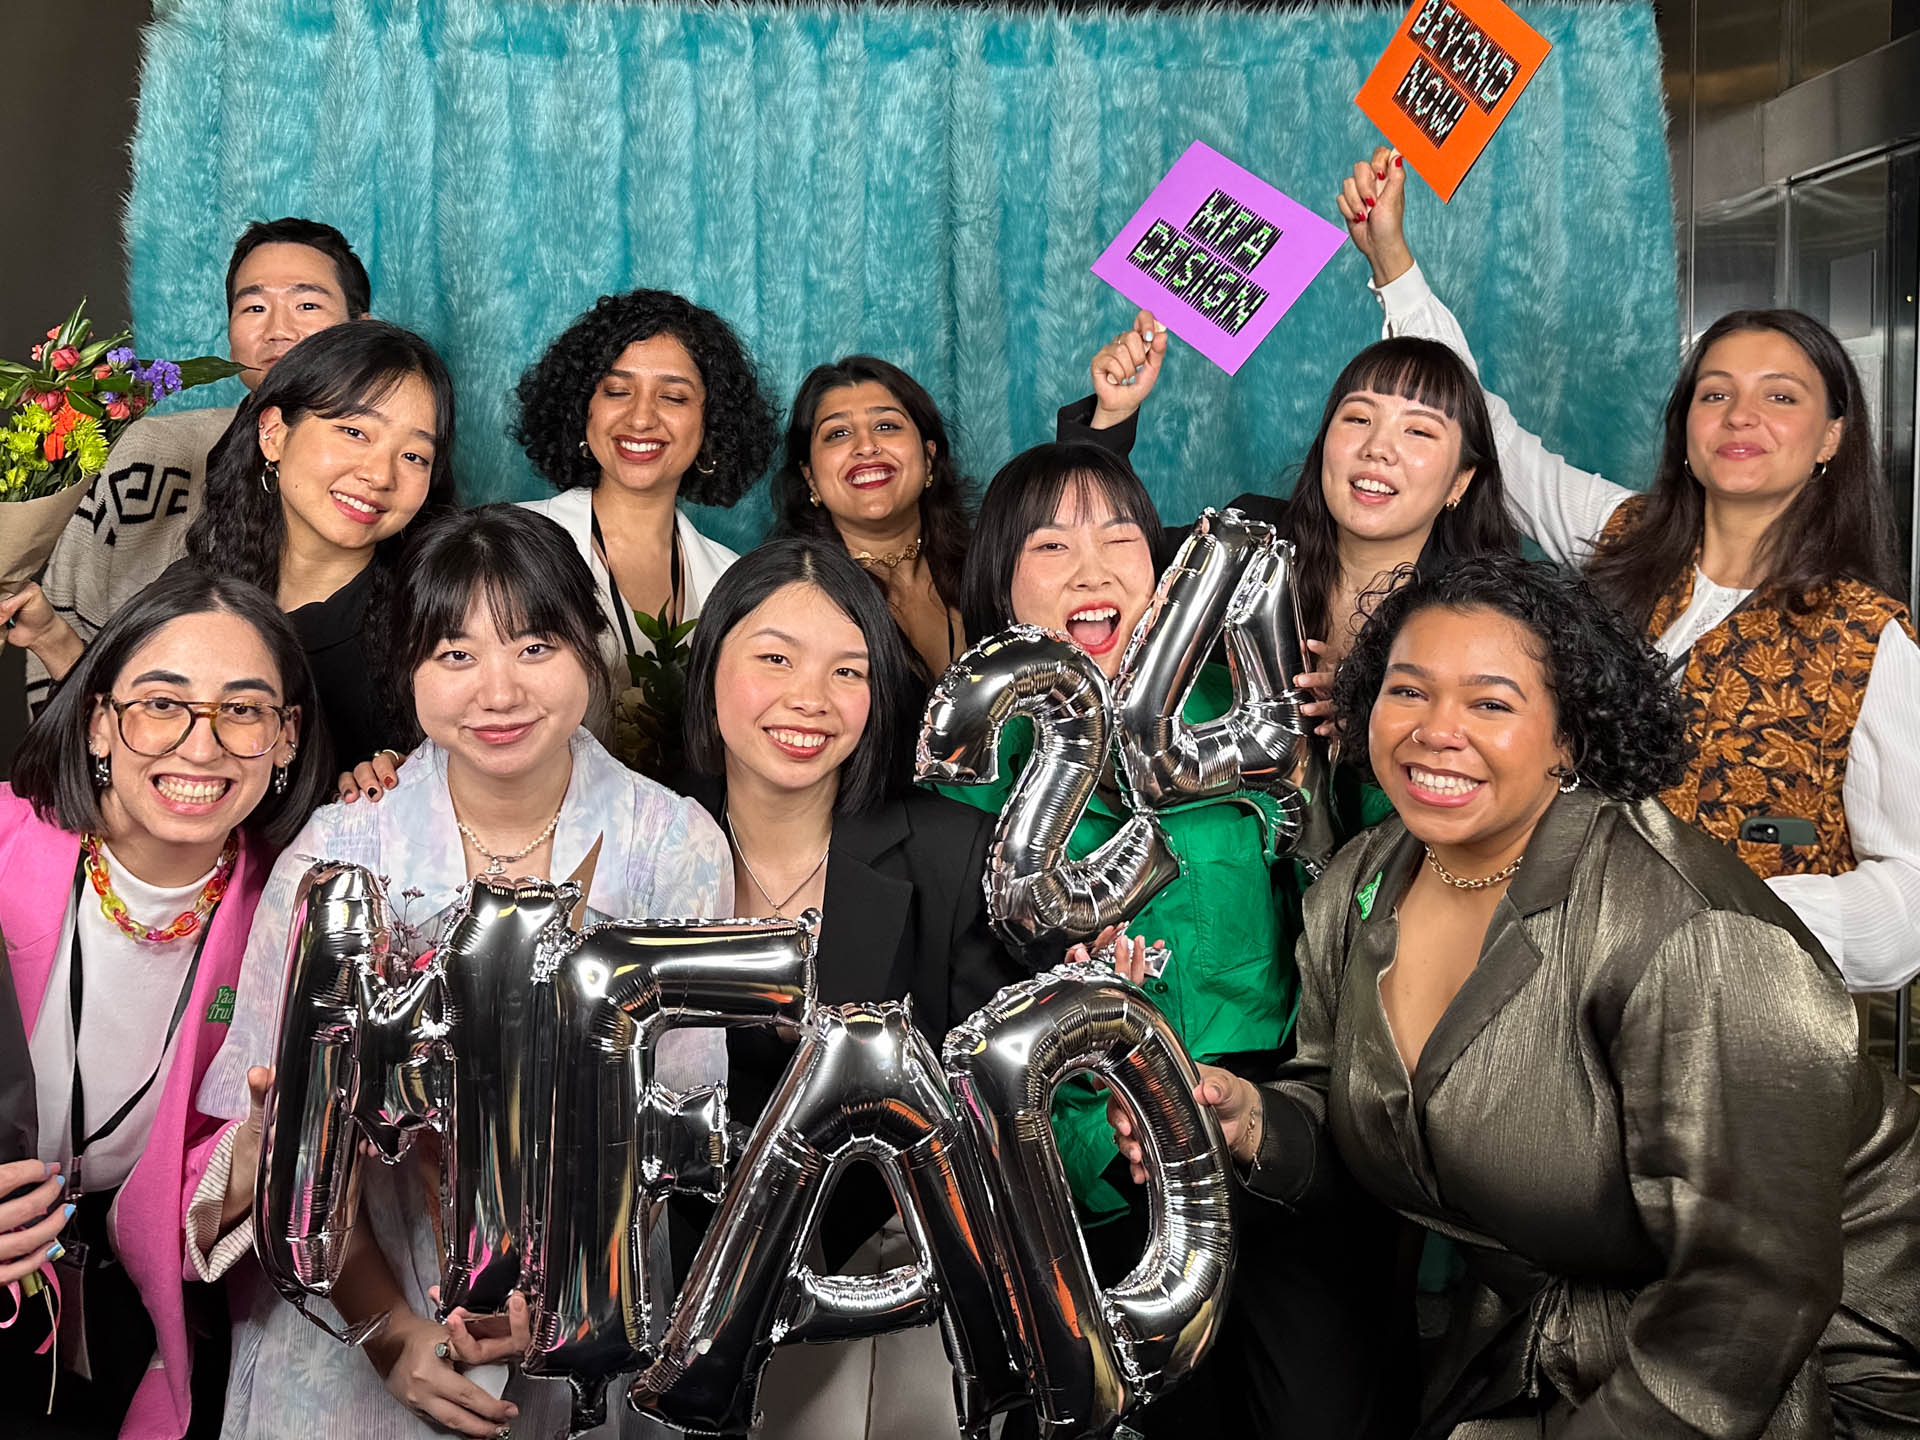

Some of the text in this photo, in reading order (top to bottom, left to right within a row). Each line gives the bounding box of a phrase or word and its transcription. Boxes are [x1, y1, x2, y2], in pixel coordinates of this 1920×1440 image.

[1396, 57, 1468, 138] NOW
[1412, 0, 1515, 106] BEYOND
[1131, 222, 1266, 330] DESIGN
[1187, 191, 1274, 269] MFA
[913, 507, 1311, 947] 24
[208, 1003, 234, 1022] Trul
